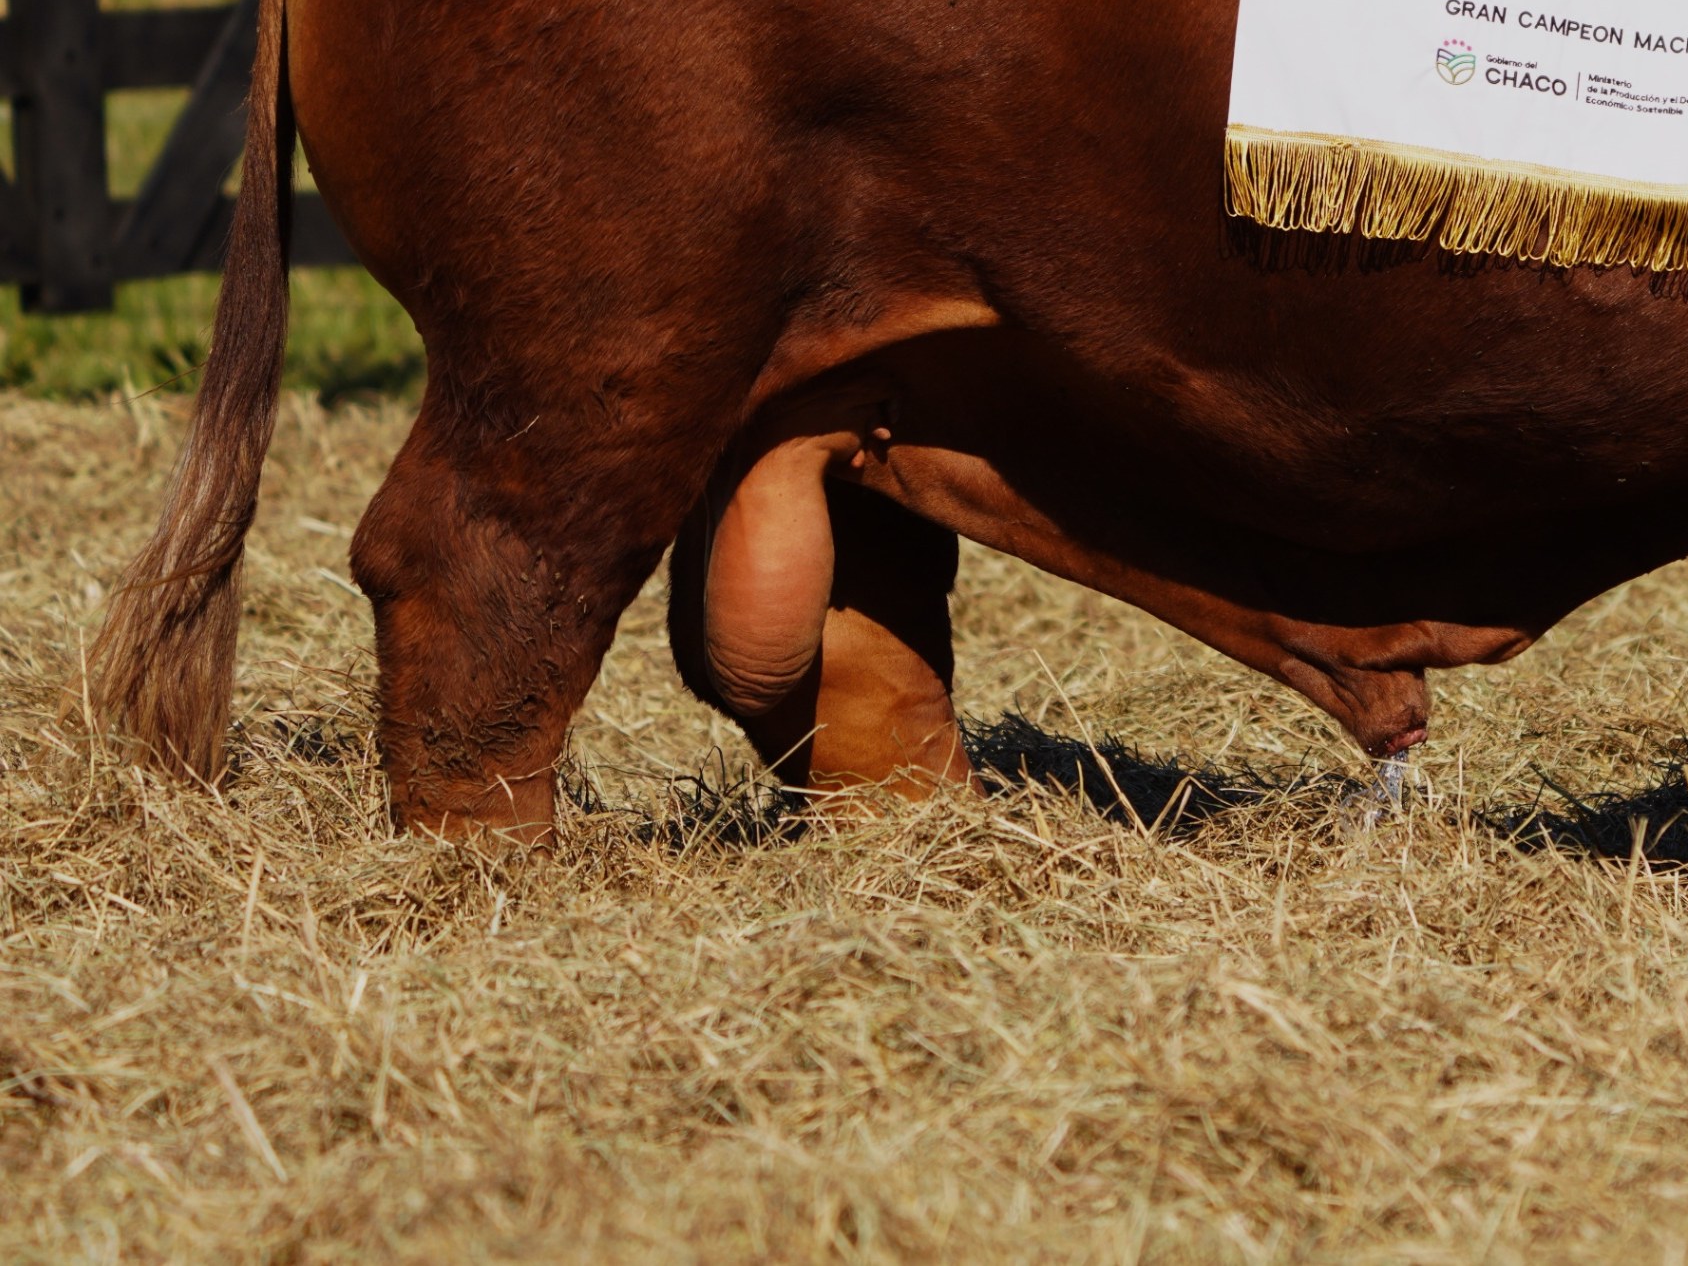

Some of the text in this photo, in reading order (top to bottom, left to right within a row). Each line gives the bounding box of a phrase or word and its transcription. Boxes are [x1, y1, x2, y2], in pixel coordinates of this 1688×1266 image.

[1518, 11, 1623, 45] CAMPEON
[1486, 54, 1538, 70] Gobierno del
[1485, 67, 1567, 96] CHACO
[1588, 74, 1633, 89] Ministerio
[1587, 85, 1598, 94] de
[1600, 86, 1608, 96] la
[1610, 88, 1661, 104] Producción
[1662, 96, 1668, 105] y
[1669, 96, 1678, 104] el
[1585, 96, 1684, 116] Económico Sostenible
